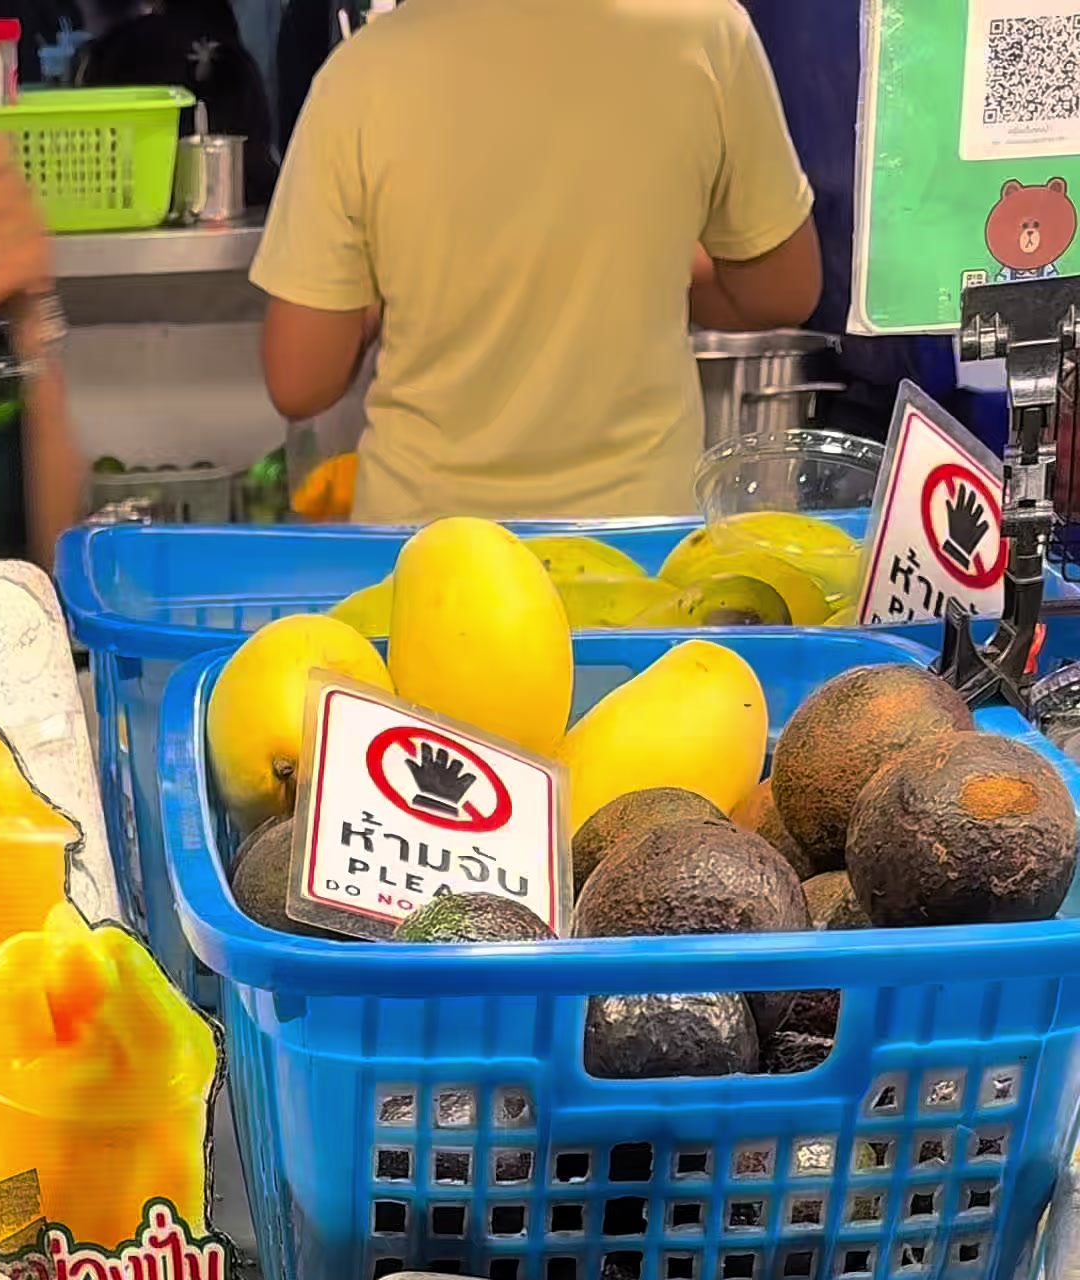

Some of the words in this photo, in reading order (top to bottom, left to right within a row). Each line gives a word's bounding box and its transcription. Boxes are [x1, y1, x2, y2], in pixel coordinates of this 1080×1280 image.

[341, 811, 528, 897] ห้ามจับ
[326, 879, 361, 897] DO
